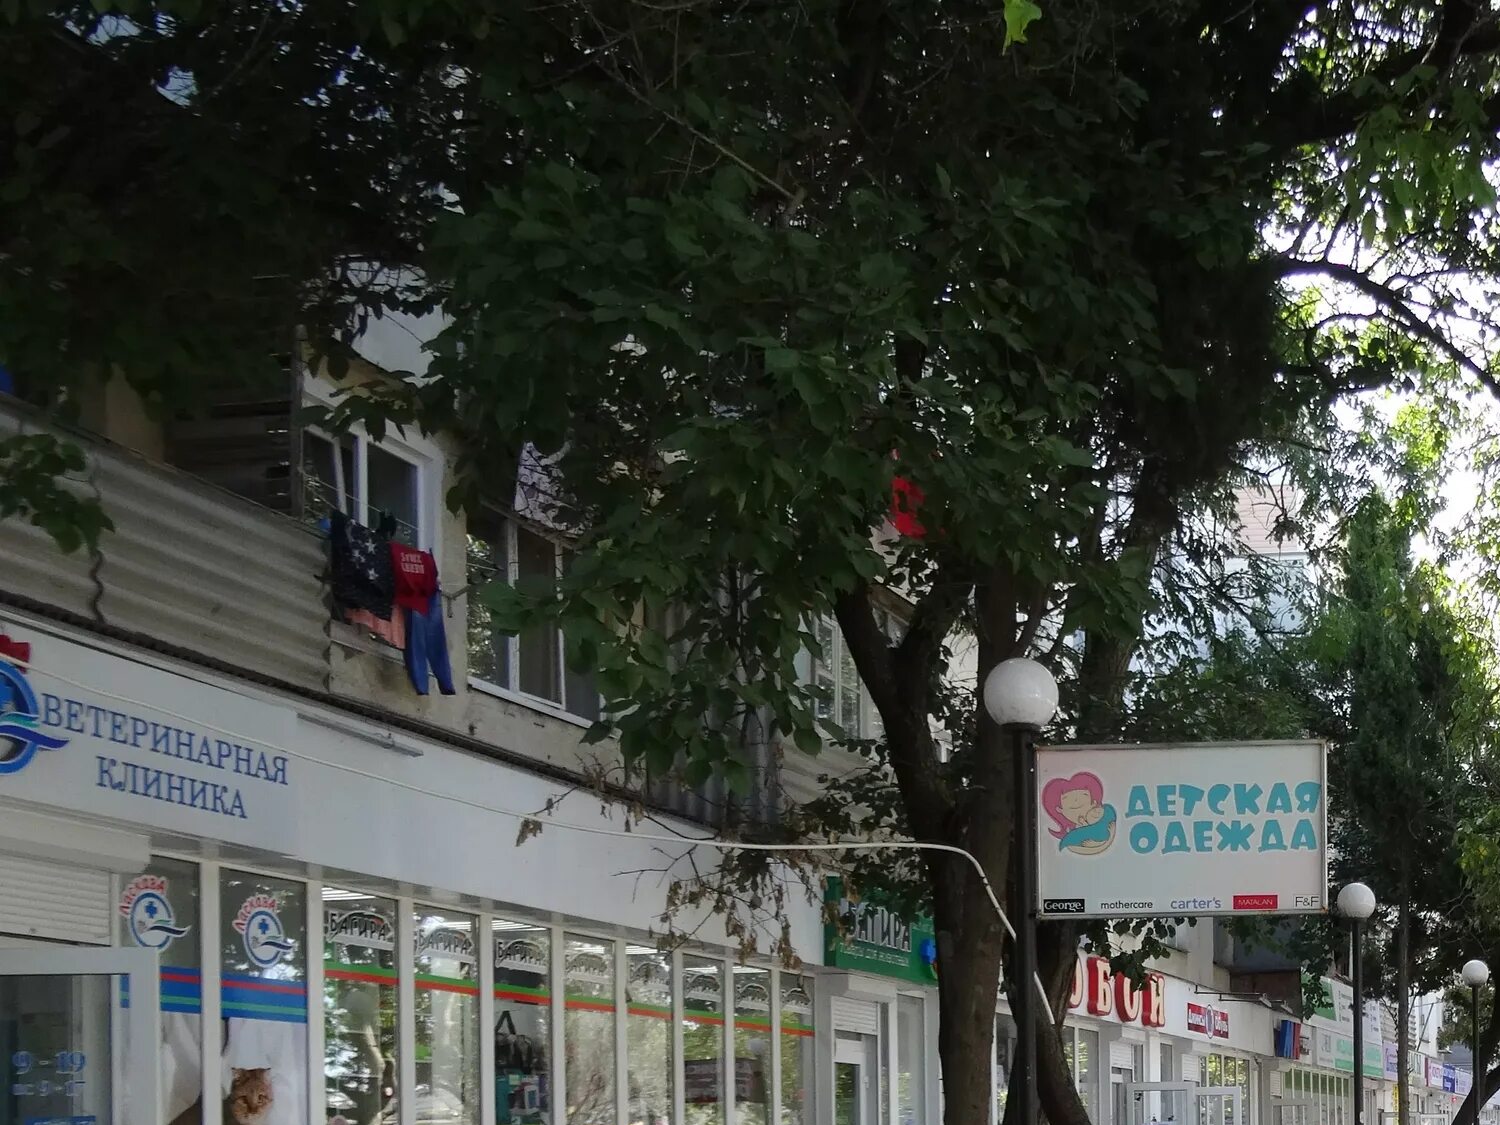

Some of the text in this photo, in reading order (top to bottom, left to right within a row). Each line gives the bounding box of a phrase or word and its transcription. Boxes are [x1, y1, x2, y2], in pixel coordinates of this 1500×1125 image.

[41, 692, 289, 785] ВЕТЕРИНАРНАЯ
[95, 756, 248, 819] КЛИНИКА
[1125, 782, 1322, 818] ДЕТСКАЯ
[1130, 819, 1318, 854] ОДЕЖДА
[1100, 900, 1153, 909] mothercare
[1171, 897, 1222, 909] carter's
[1238, 898, 1273, 906] MATALAN
[1295, 897, 1320, 906] F&F
[329, 911, 388, 941] БАГИРА
